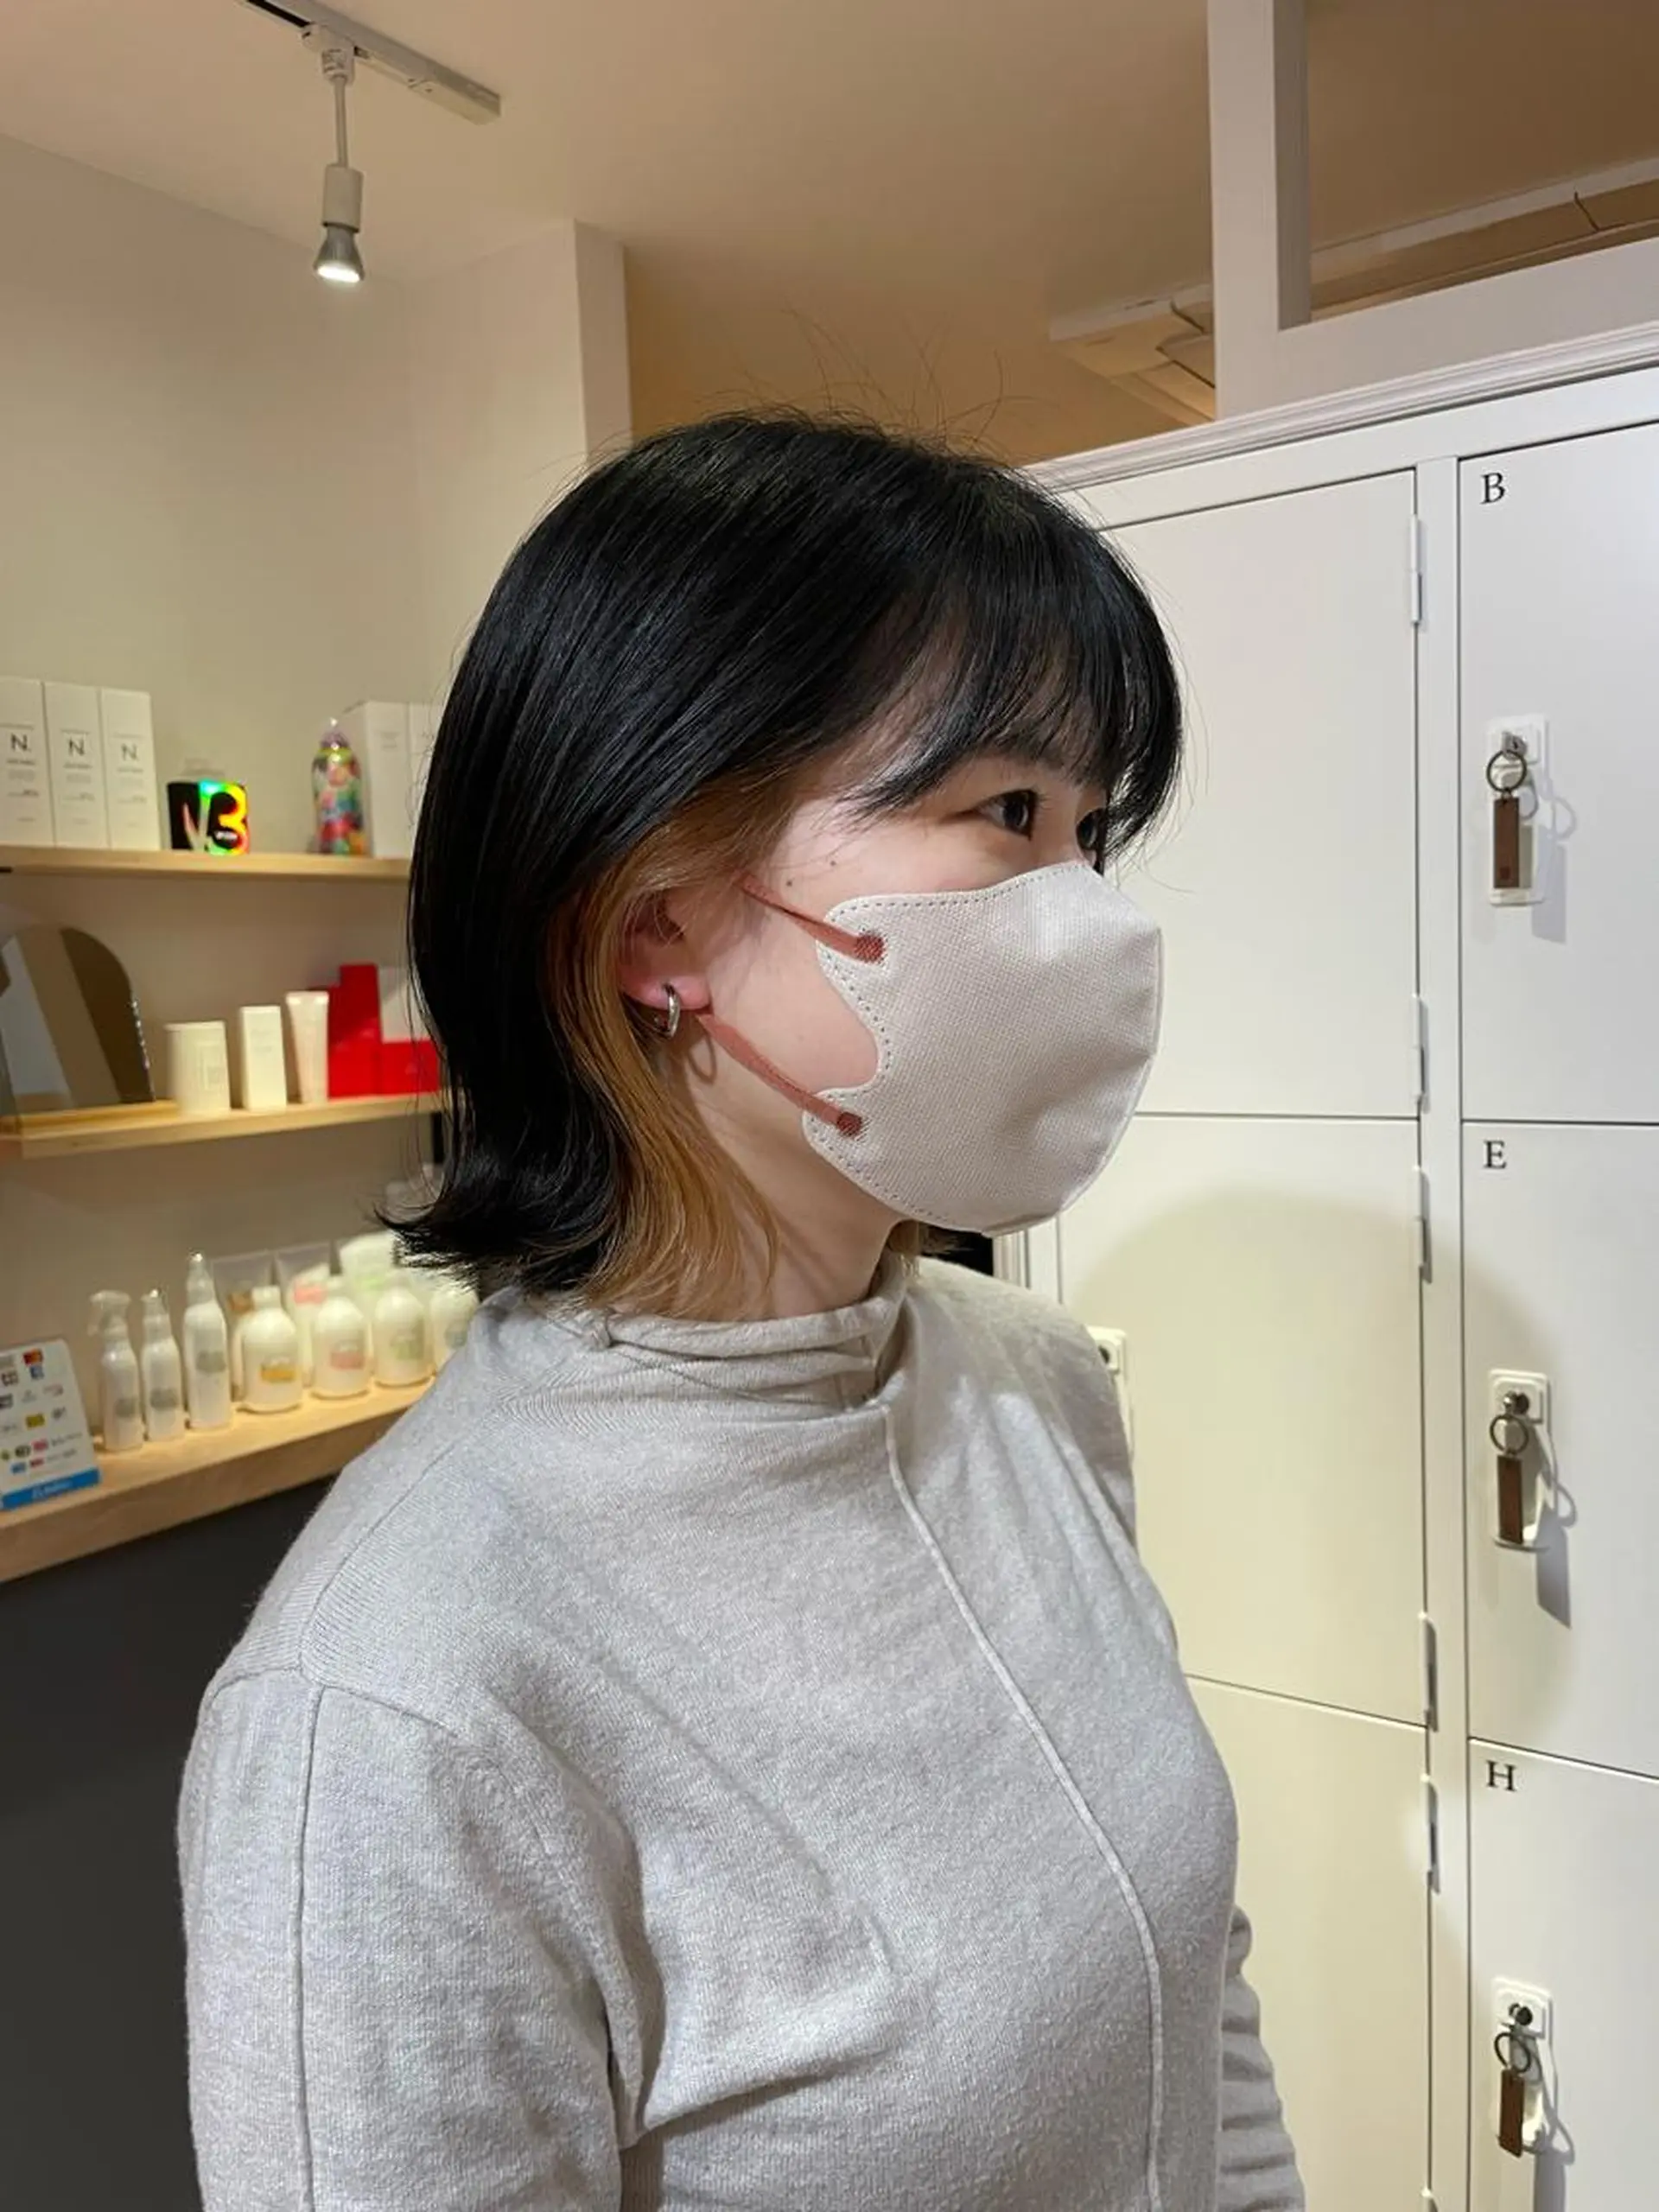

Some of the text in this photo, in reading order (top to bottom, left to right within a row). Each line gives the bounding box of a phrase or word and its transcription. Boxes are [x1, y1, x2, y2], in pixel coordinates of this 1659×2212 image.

[1481, 473, 1507, 504] B
[1483, 1140, 1507, 1169] E
[1486, 1760, 1516, 1792] H
